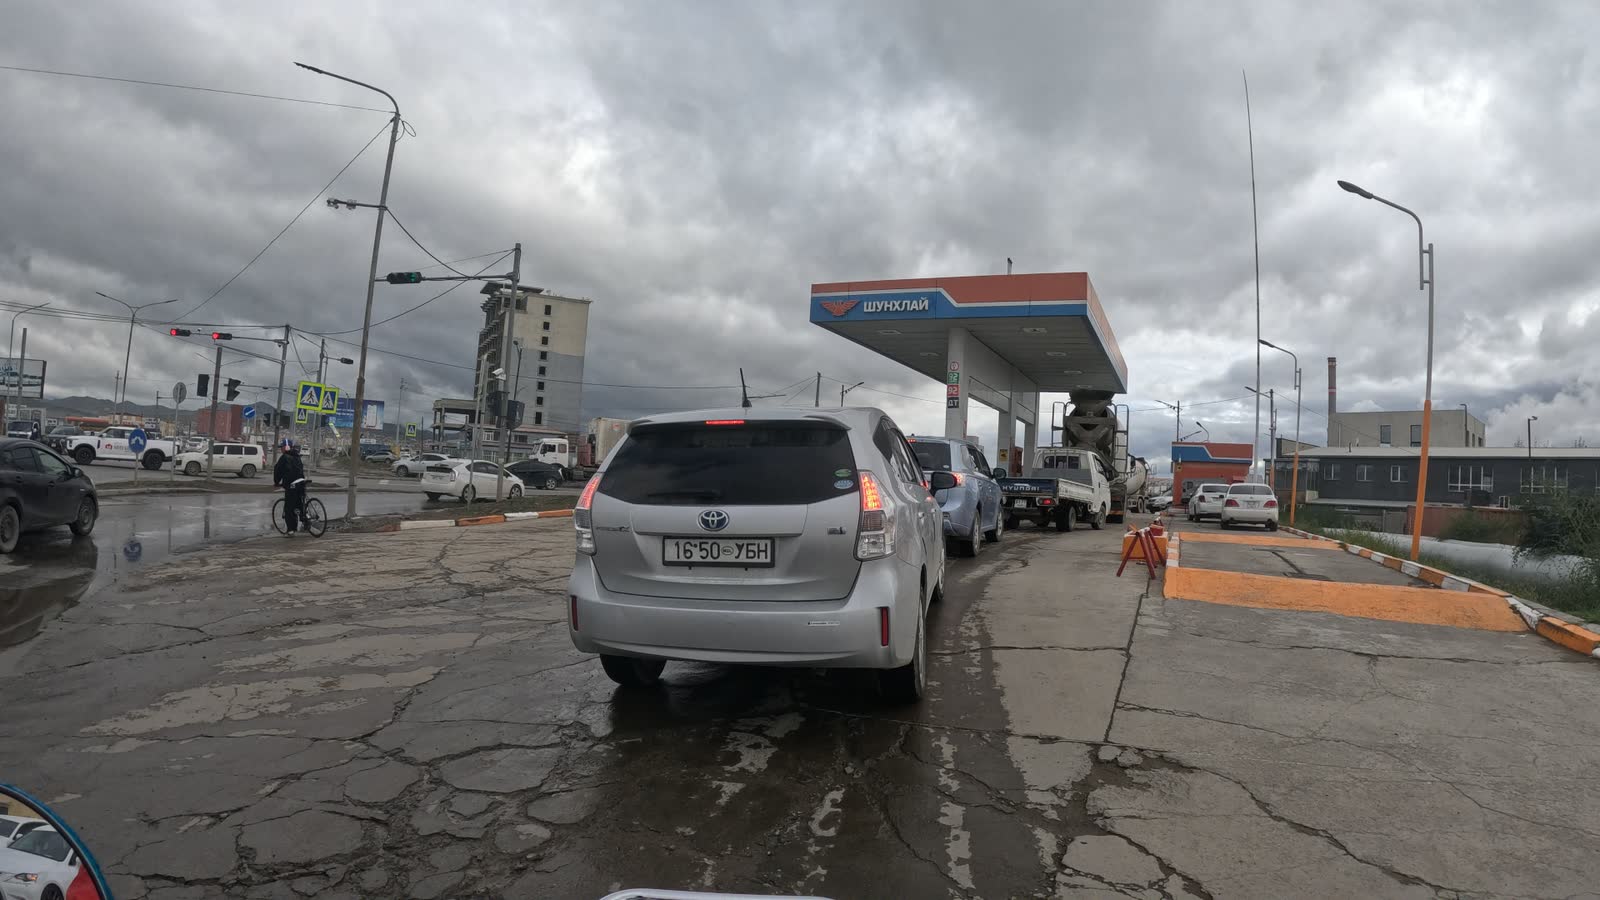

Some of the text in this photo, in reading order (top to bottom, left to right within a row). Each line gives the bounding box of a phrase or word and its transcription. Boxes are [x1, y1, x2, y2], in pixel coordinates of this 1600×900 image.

[863, 296, 929, 312] ШУНХЛАЙ
[948, 386, 958, 395] 92
[734, 542, 768, 560] УБН
